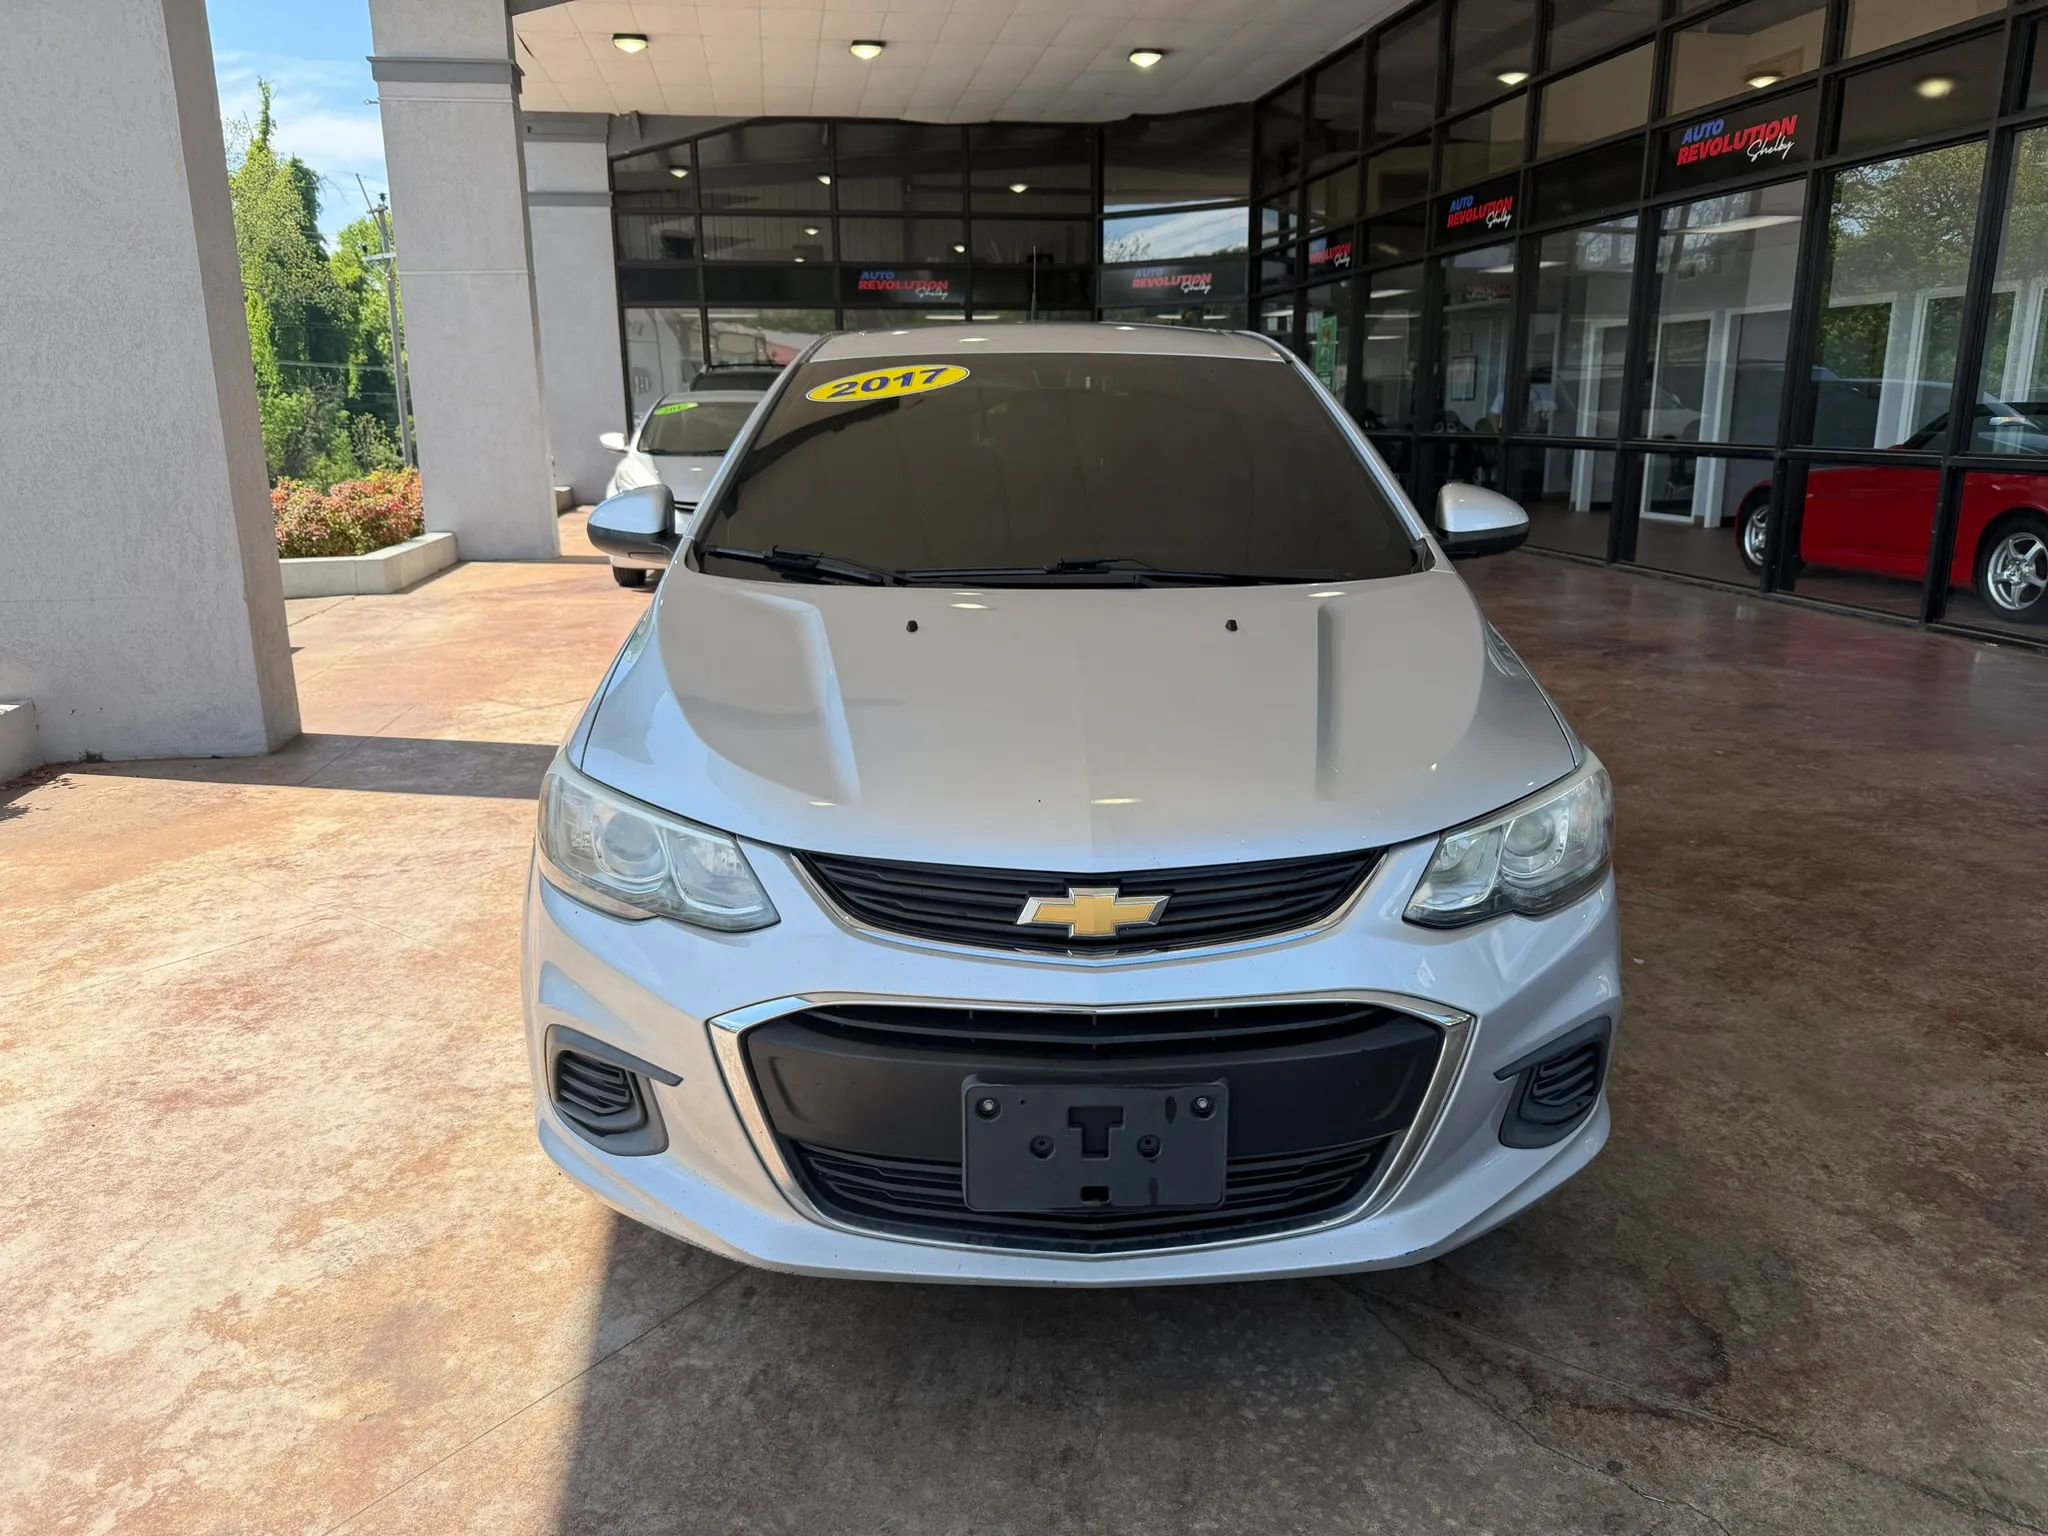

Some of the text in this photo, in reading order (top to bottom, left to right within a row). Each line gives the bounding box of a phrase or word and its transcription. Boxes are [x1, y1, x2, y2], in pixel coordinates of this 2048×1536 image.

[1677, 114, 1798, 167] REVOLUTION
[1682, 118, 1725, 145] AUTO
[1746, 131, 1795, 162] Shelby
[1447, 196, 1513, 228] REVOLUTION
[1449, 195, 1474, 213] AUTO
[858, 280, 949, 291] REVOLUTION
[861, 270, 895, 281] AUTO
[1132, 273, 1212, 289] REVOLUTION
[826, 367, 949, 399] 2017
